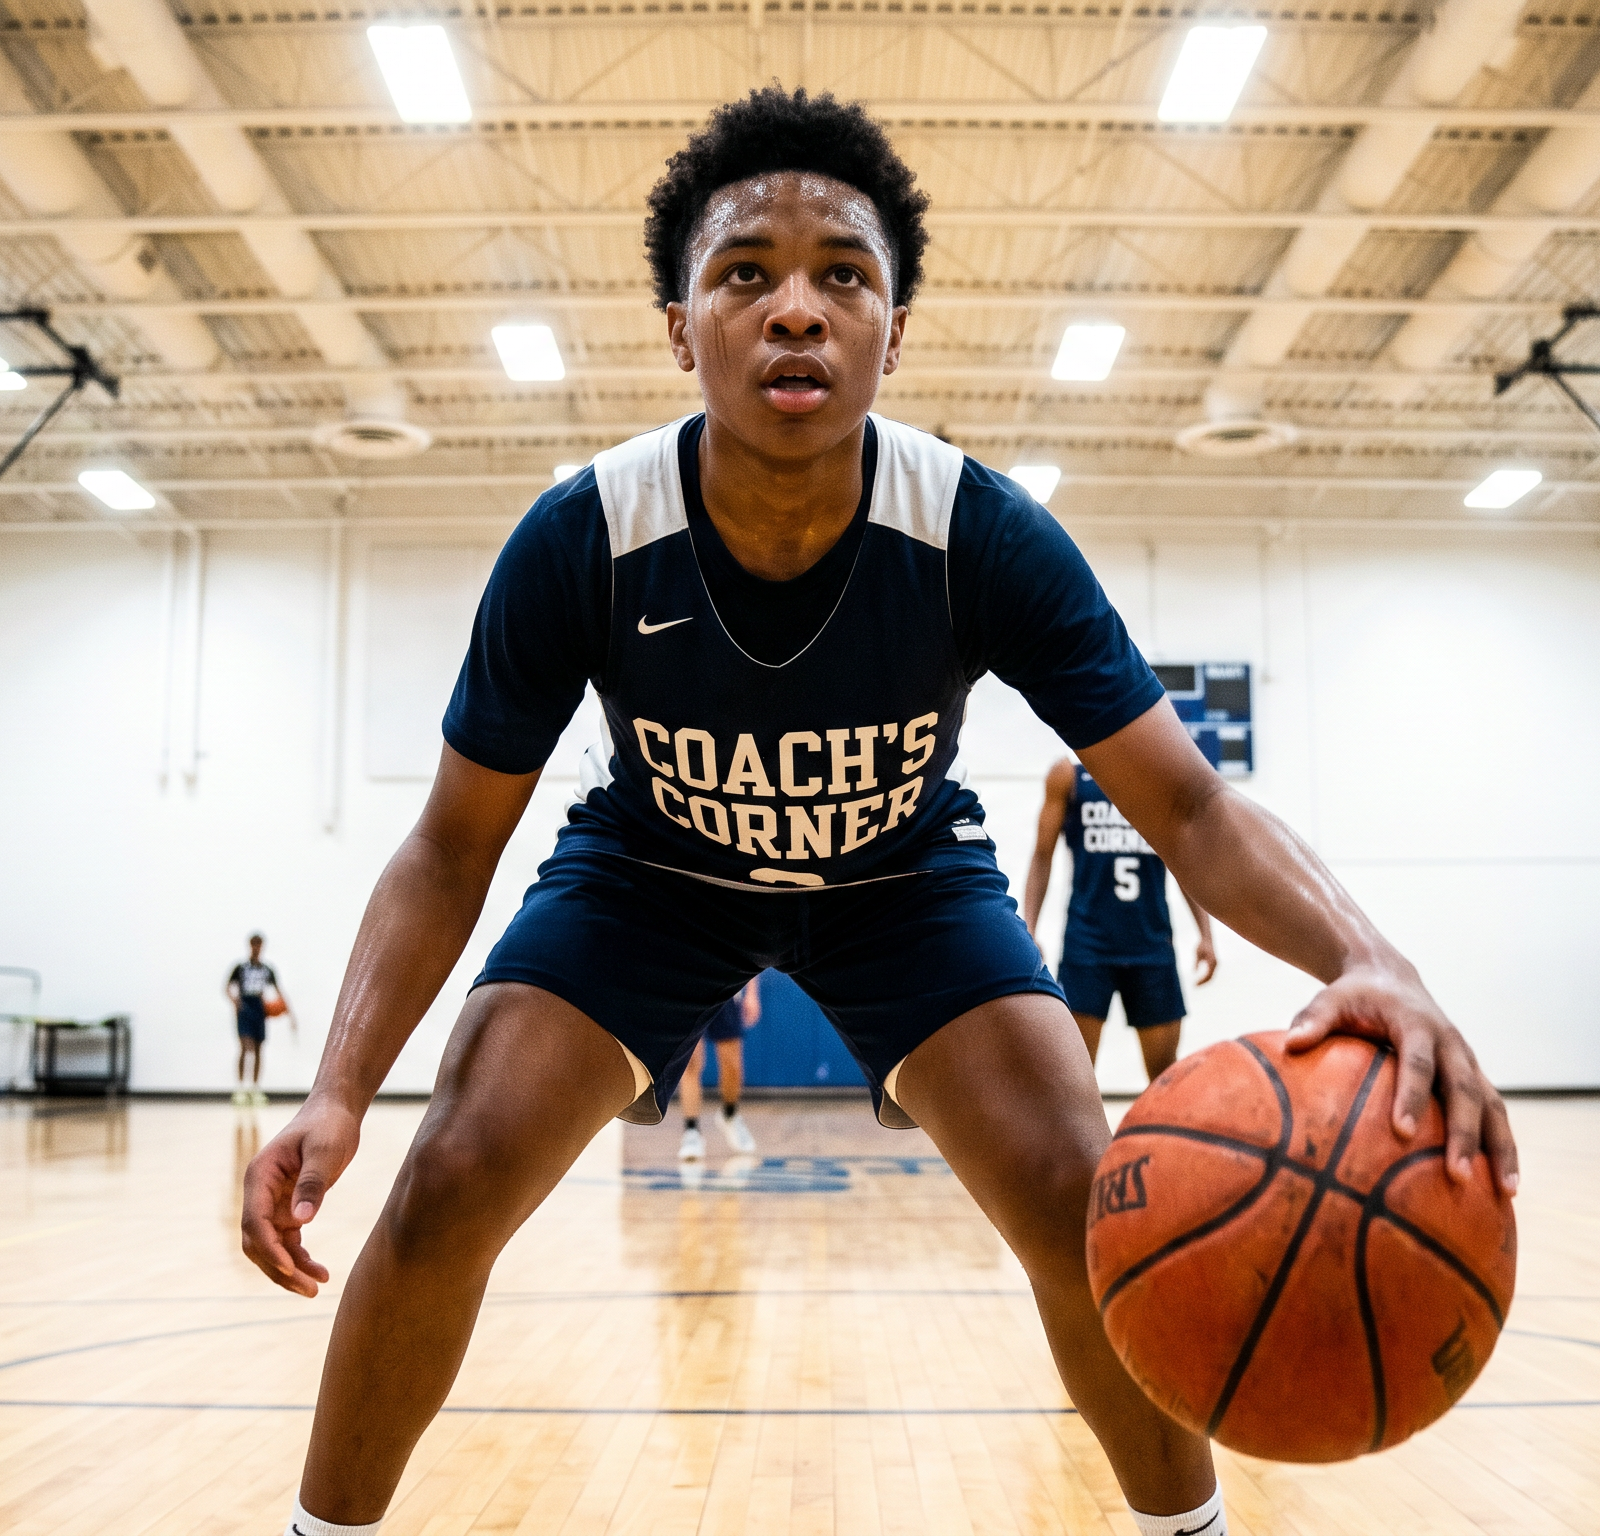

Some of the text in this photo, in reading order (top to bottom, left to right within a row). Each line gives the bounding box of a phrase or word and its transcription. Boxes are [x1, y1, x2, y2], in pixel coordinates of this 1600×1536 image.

[633, 711, 938, 797] COACH'S
[652, 775, 924, 860] CORNER
[1113, 856, 1141, 902] 5
